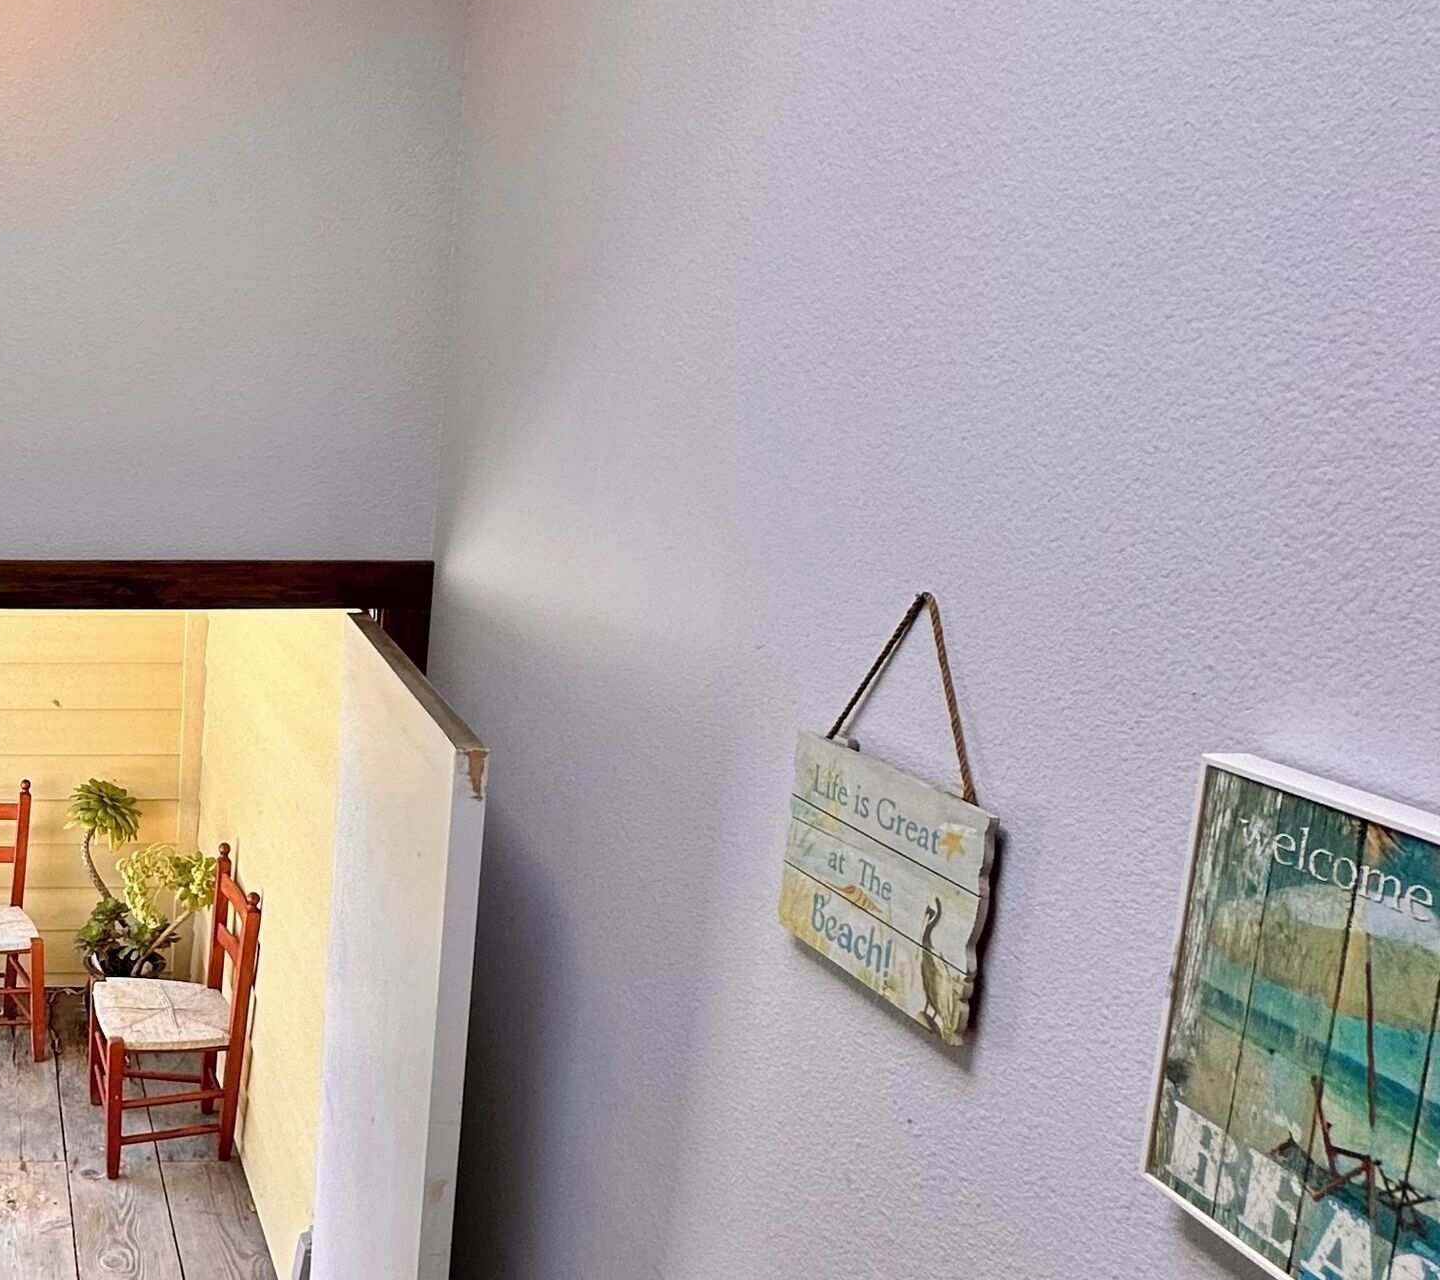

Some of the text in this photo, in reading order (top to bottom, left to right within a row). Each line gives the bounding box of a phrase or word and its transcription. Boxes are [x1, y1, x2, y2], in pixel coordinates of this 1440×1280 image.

[812, 763, 941, 855] Life is Great
[827, 850, 893, 901] at The
[1240, 818, 1434, 922] welcome
[811, 891, 894, 978] Beach!
